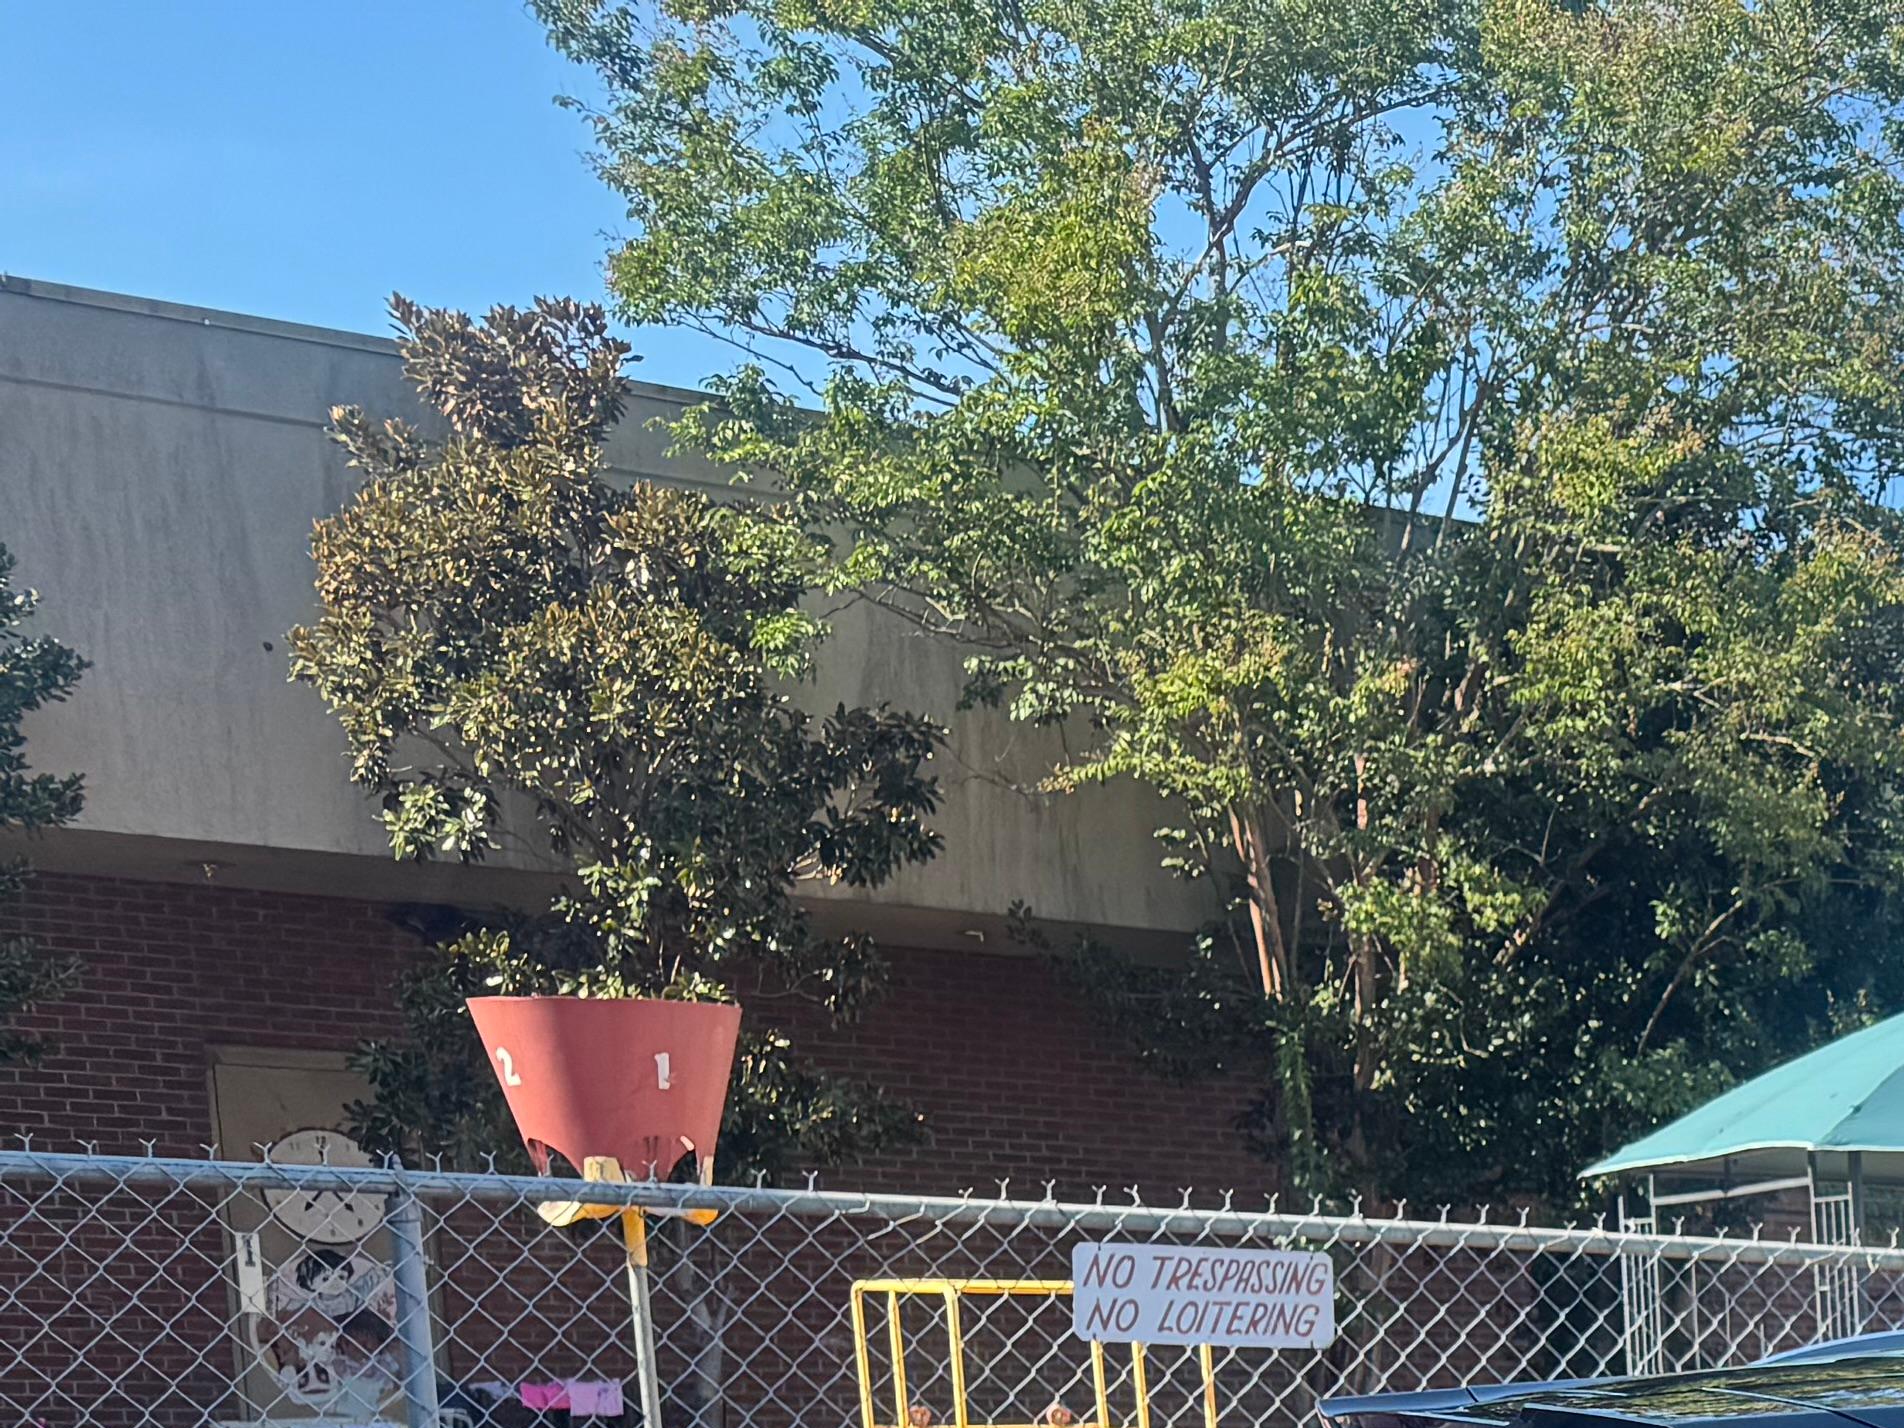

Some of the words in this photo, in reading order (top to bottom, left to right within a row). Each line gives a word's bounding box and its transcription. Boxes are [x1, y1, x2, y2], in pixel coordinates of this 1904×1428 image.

[496, 1047, 522, 1086] 2
[655, 1053, 671, 1090] 1
[1083, 1253, 1136, 1289] NO
[1151, 1255, 1328, 1296] TRESPASSING
[1086, 1297, 1140, 1333] NO
[1158, 1300, 1320, 1337] LOITERING
